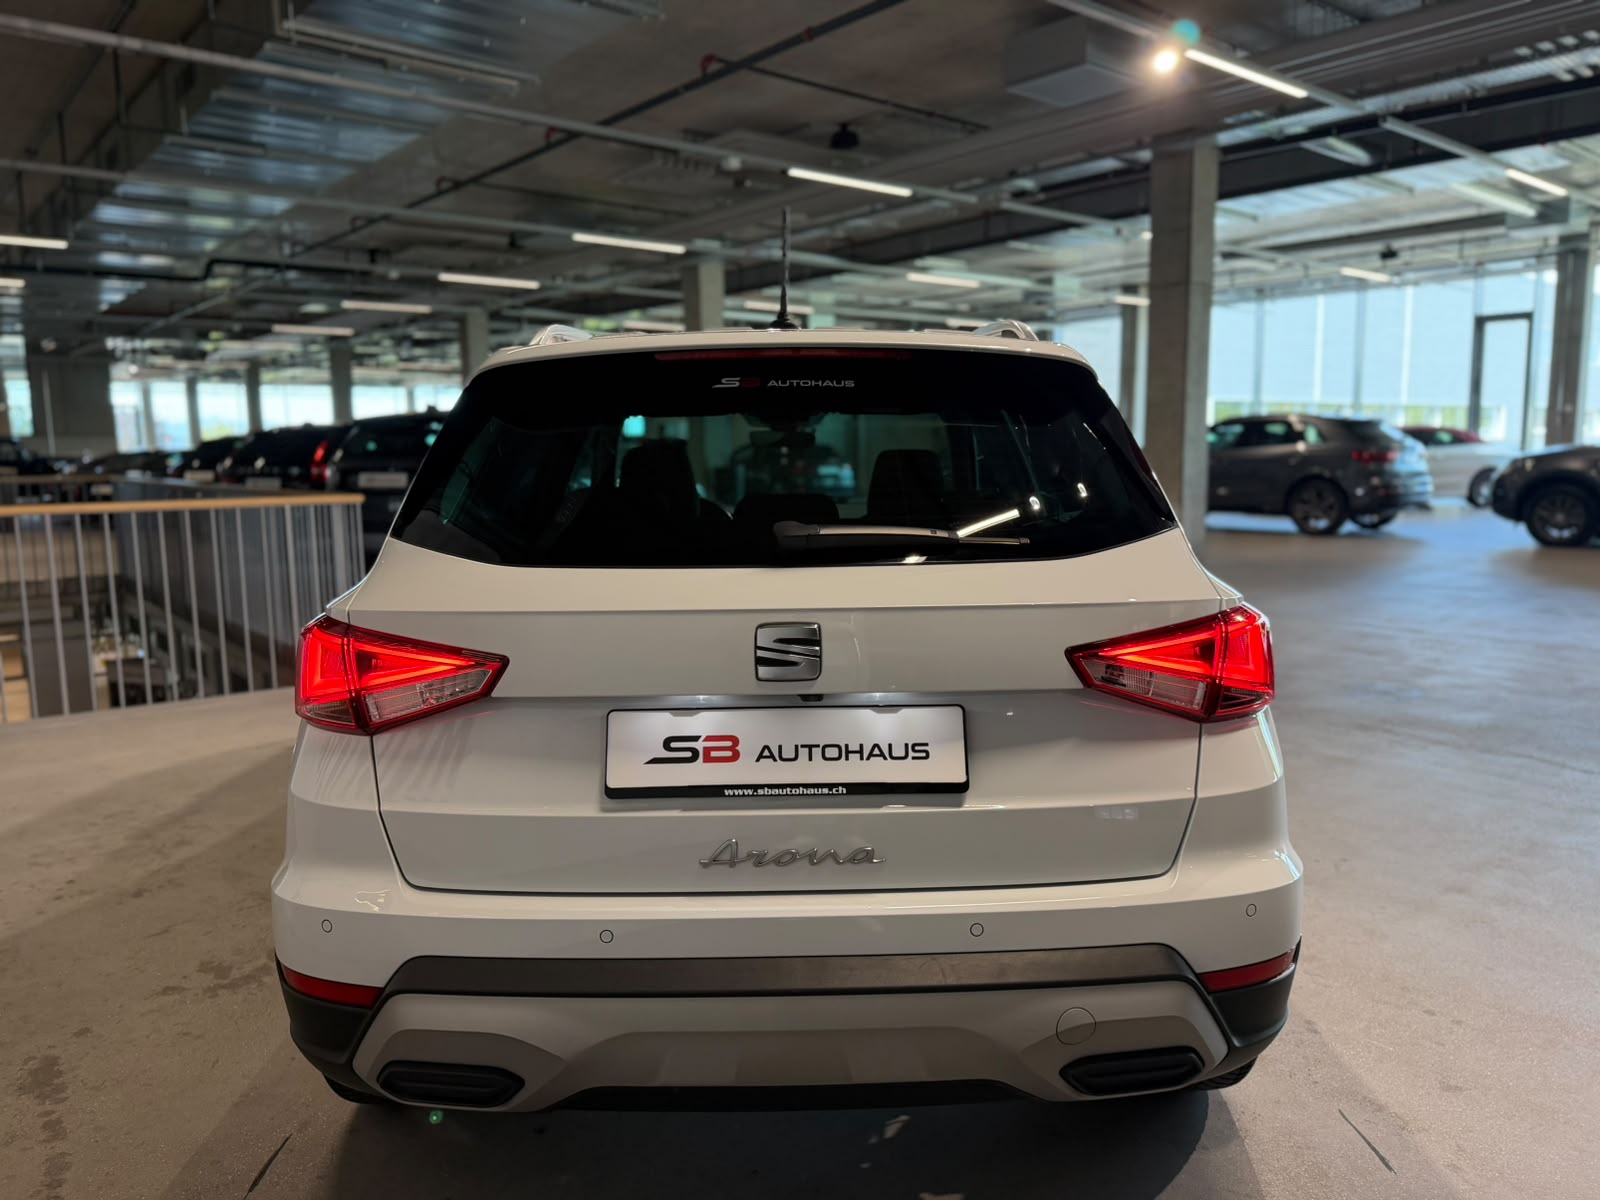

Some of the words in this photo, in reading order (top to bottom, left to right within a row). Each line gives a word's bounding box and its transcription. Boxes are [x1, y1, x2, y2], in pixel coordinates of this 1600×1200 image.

[767, 379, 855, 388] AUTOHAUS
[643, 734, 741, 765] SB
[754, 742, 930, 763] AUTOHAUS
[723, 786, 847, 796] www.sbautohaus.ch
[699, 838, 887, 868] Arona
